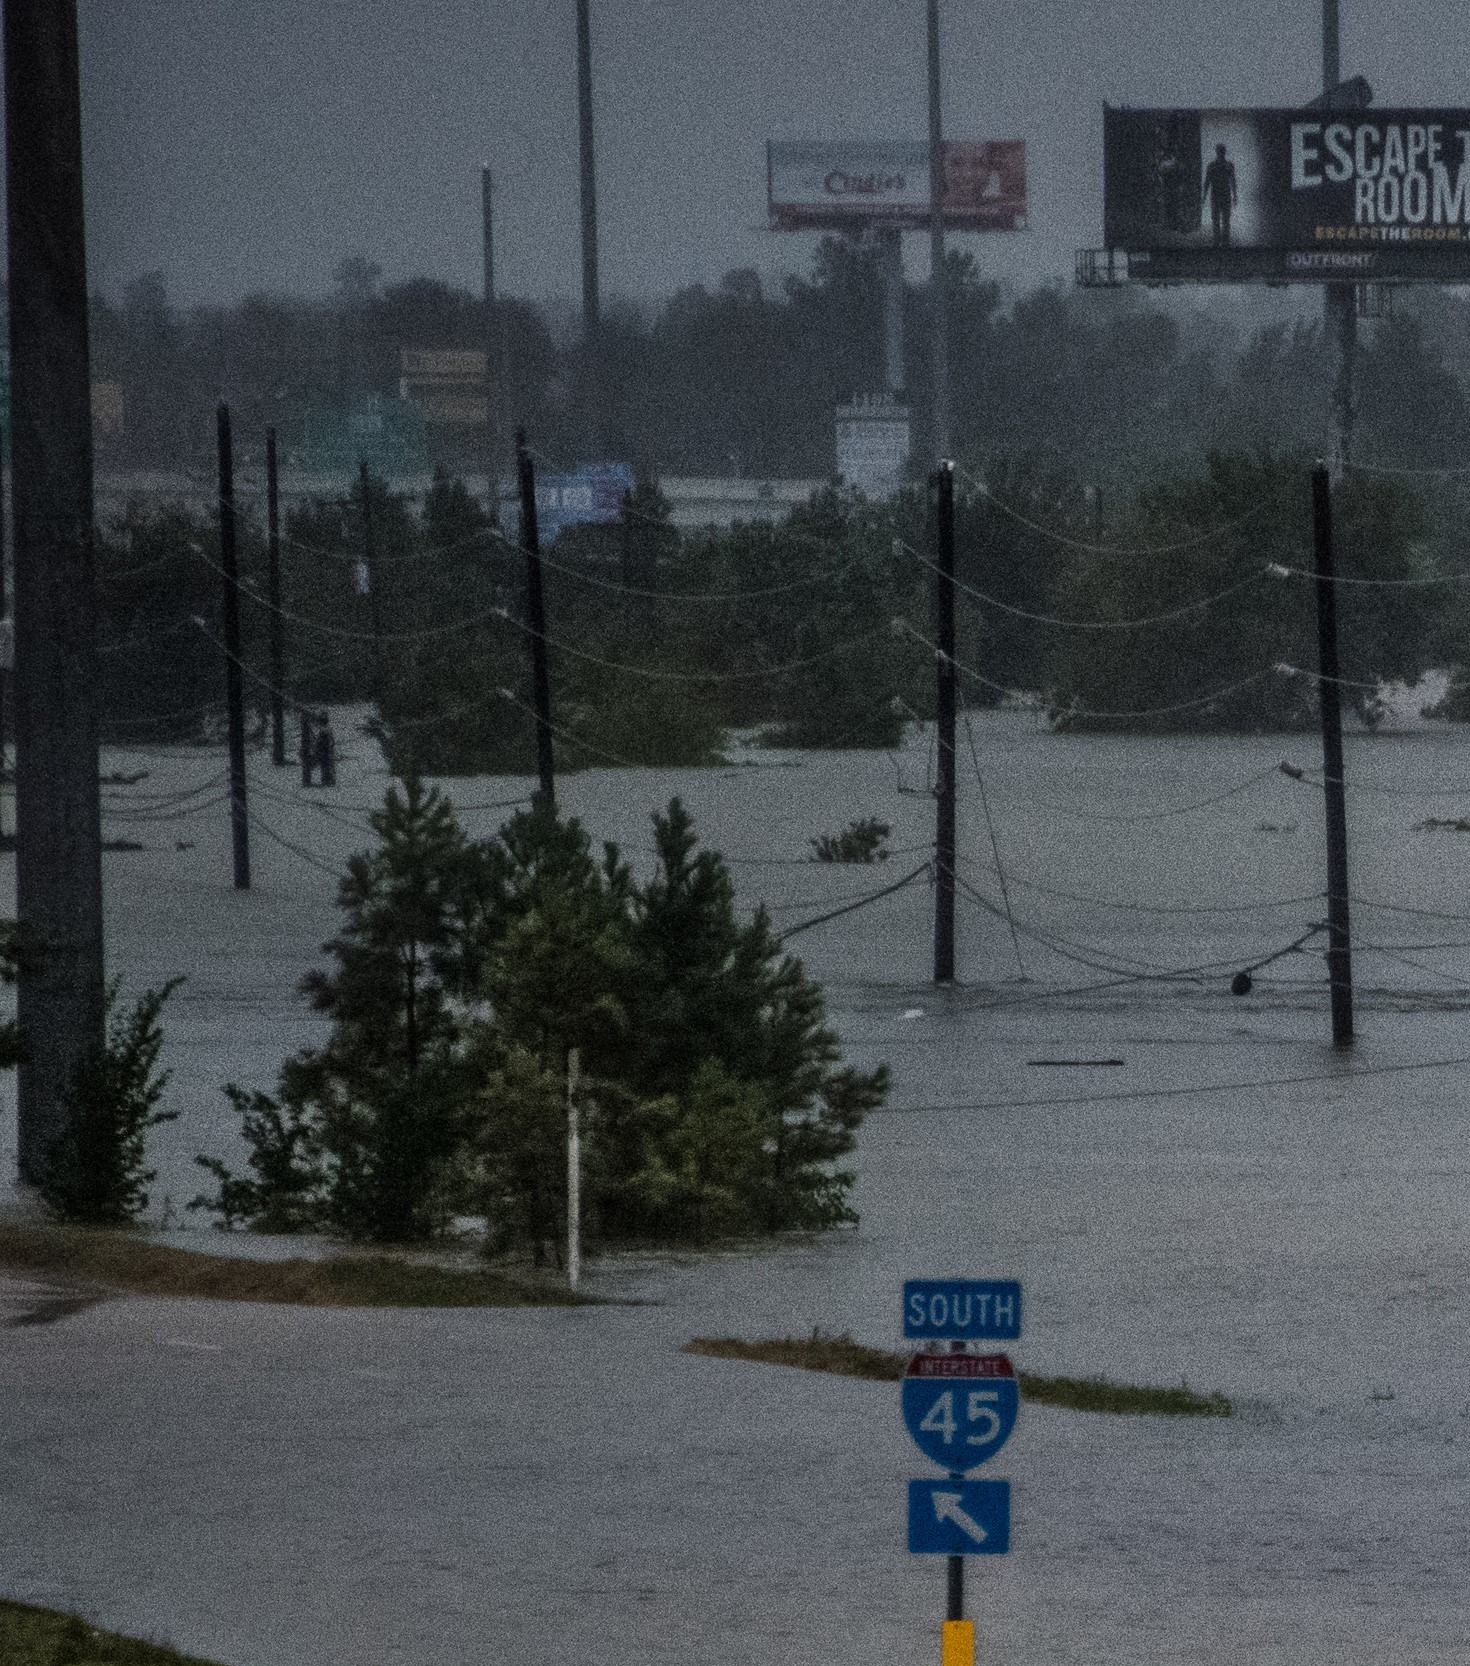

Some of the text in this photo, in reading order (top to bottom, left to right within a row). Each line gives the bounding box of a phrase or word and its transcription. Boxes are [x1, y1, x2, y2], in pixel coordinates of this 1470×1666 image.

[1290, 122, 1444, 191] ESCAPE
[907, 1293, 1014, 1327] SOUTH
[919, 1358, 1001, 1376] INTERSTATE
[920, 1391, 1001, 1446] 45
